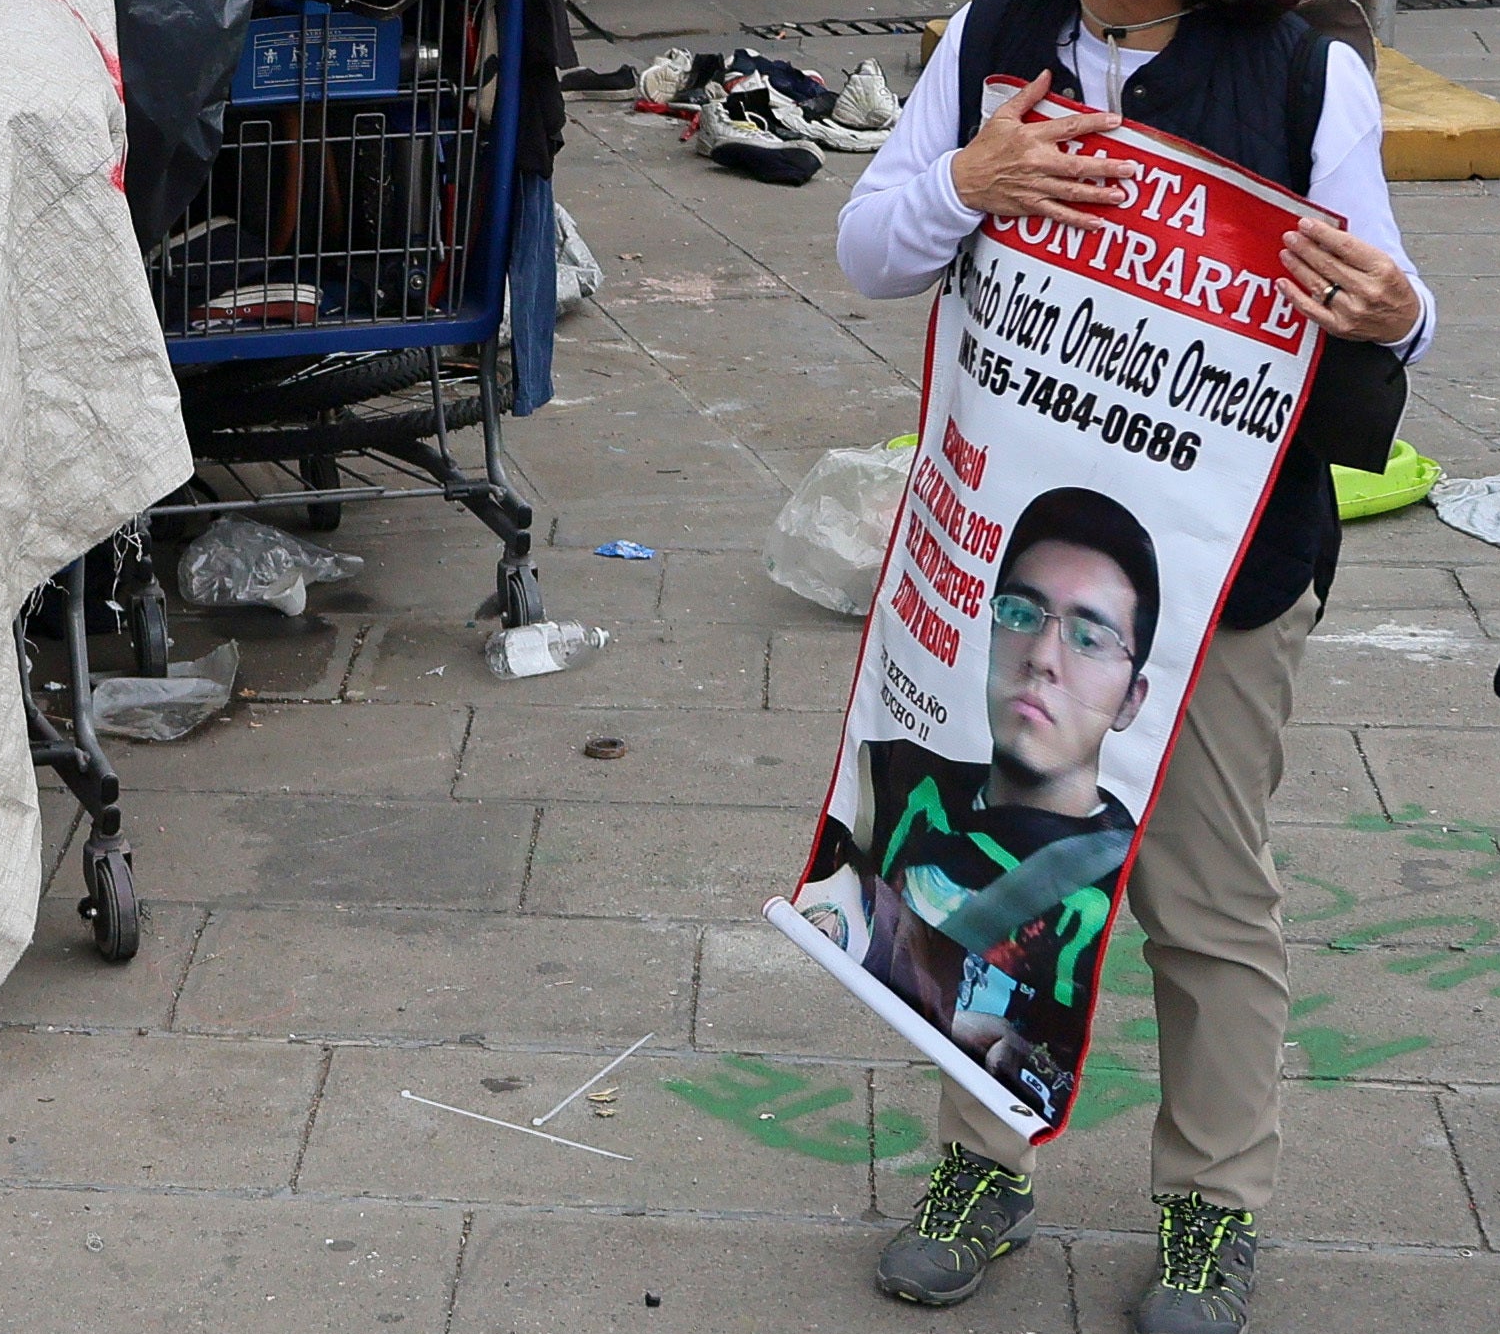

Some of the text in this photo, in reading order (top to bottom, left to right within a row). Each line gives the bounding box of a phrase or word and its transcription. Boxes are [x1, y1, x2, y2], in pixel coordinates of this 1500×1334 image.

[996, 271, 1061, 356] Iván
[1061, 297, 1169, 398] Ornelas
[1168, 340, 1293, 444] Ornelas
[962, 511, 1004, 564] 2019
[886, 659, 948, 725] EXTRAÑO
